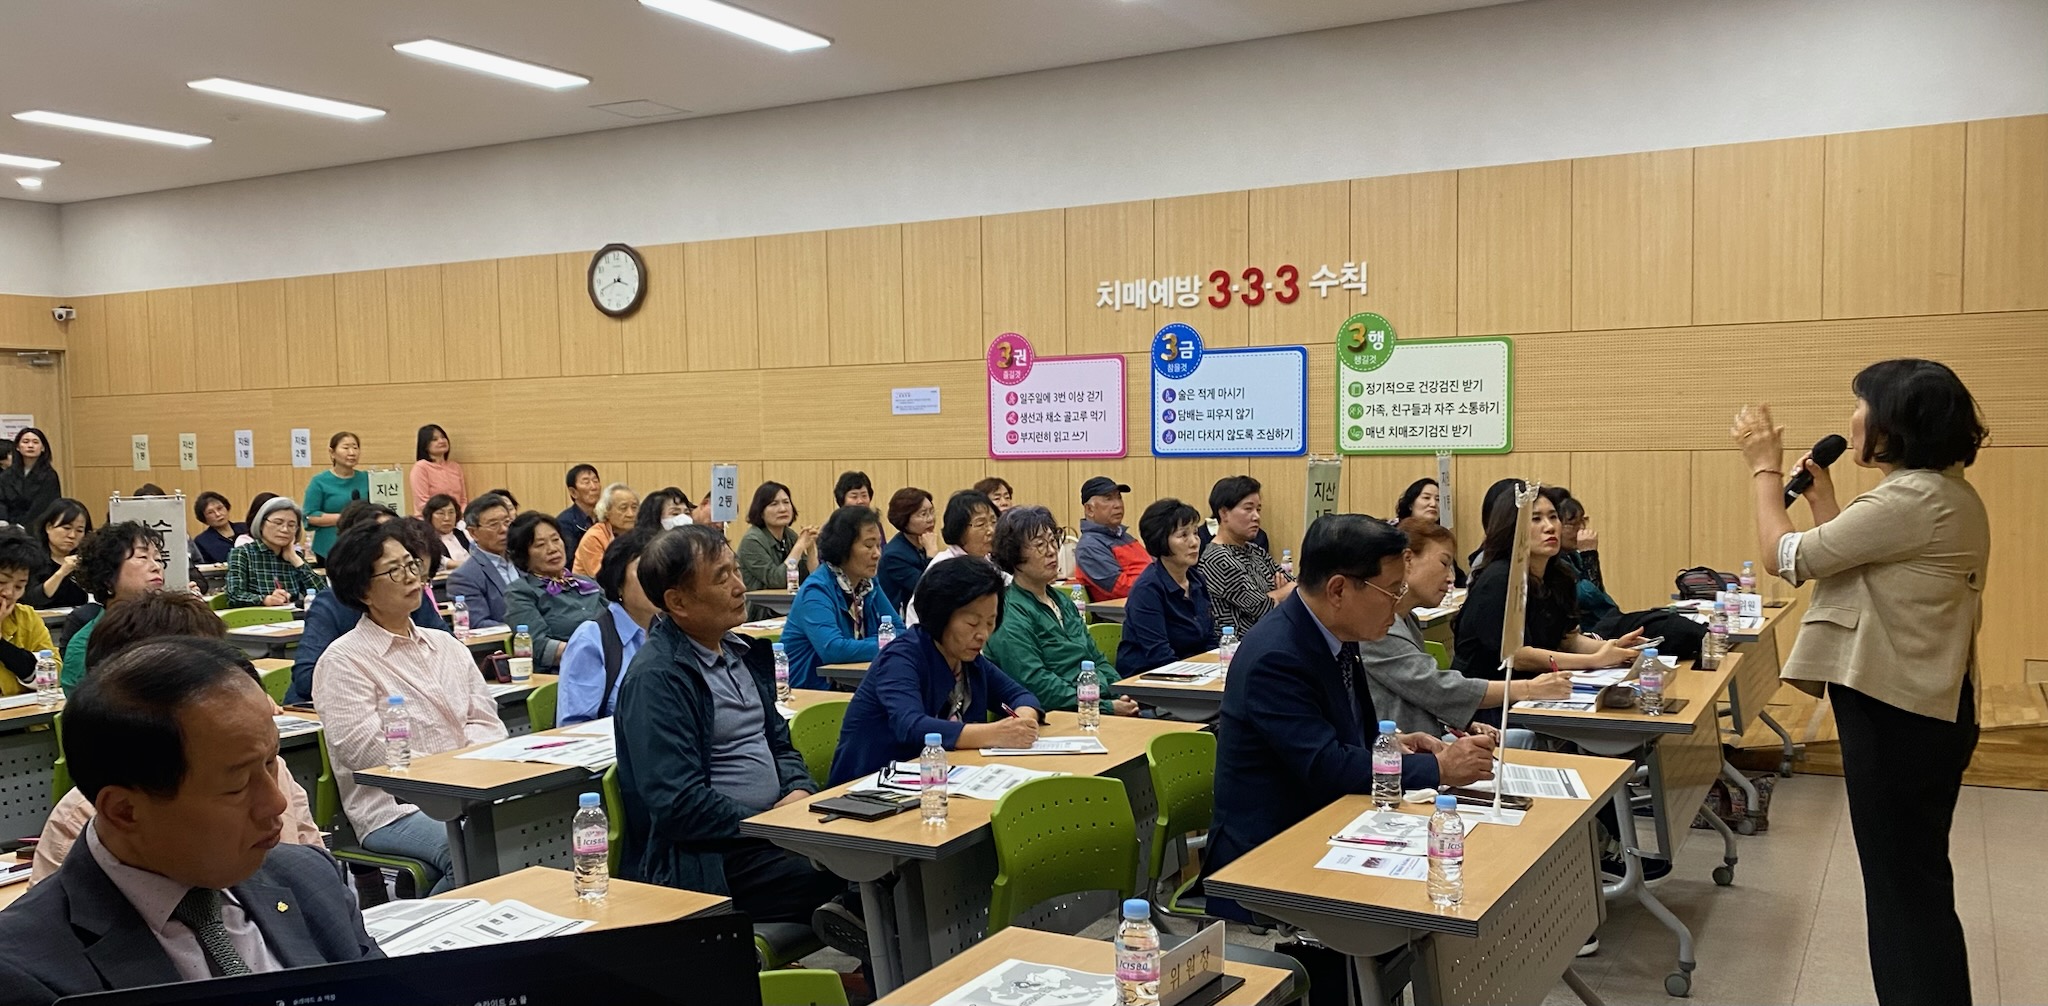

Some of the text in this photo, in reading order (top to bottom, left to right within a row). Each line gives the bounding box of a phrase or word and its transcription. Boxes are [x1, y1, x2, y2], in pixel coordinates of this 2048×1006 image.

[1096, 274, 1203, 311] 치매예방
[1308, 261, 1368, 299] 수칙
[1177, 387, 1245, 401] 술은 적게 마시기
[1365, 378, 1483, 396] 정기적으로 건강검진 받기
[1020, 390, 1103, 405] 일주일에 3번 이상 걷기
[1177, 408, 1254, 421] 담배는 피우지 않기
[1365, 401, 1500, 417] 가족, 친구들과 자주 소통하기
[1020, 410, 1107, 424] 생선과 채소 골고루 먹기
[1020, 430, 1088, 443] 부지런히 읽고 쓰기
[1177, 428, 1293, 441] 머리 다치지 않도록 조심하기
[1365, 424, 1472, 438] 매년 치매조기검진 받기
[376, 482, 399, 497] 지산
[717, 477, 734, 489] 지원
[1314, 481, 1336, 502] 지산
[718, 495, 733, 508] 2동
